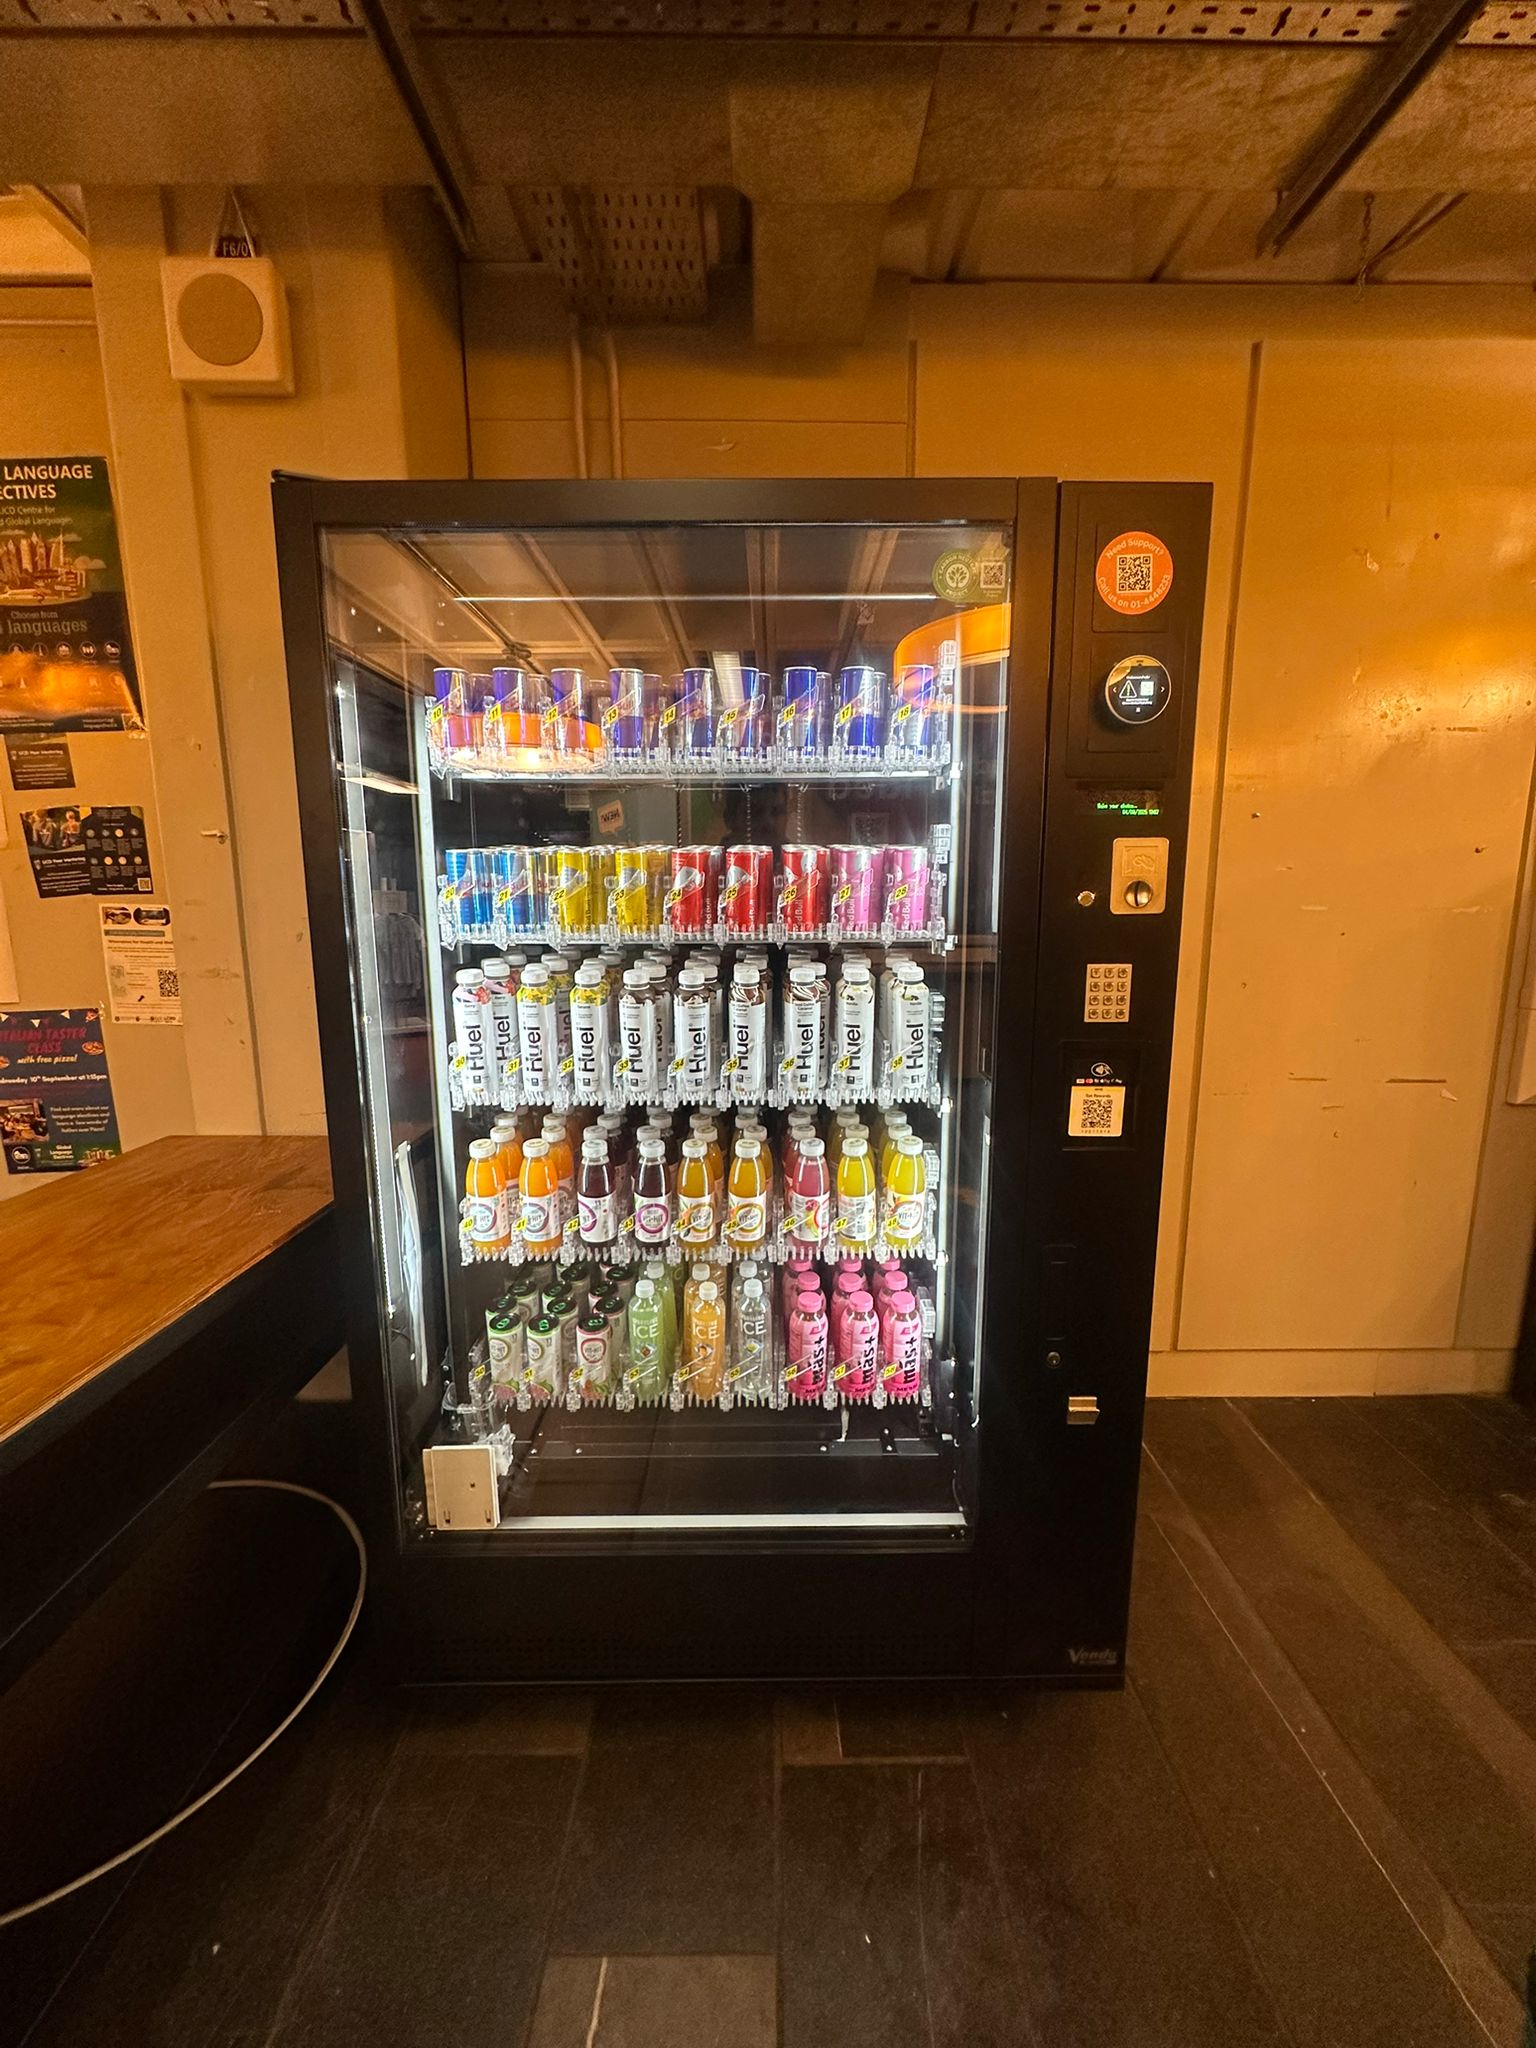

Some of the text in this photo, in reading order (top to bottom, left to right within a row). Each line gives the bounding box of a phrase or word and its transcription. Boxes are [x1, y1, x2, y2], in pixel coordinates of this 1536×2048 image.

[4, 465, 93, 480] LANGUAGE
[17, 505, 43, 515] Centre
[44, 504, 56, 513] for
[1105, 538, 1165, 559] Need Support?
[1099, 577, 1111, 594] Call
[1108, 594, 1118, 603] us
[1118, 600, 1129, 608] on
[8, 620, 88, 636] languages
[432, 707, 443, 719] 10
[490, 706, 500, 718] 11
[607, 708, 617, 720] 13
[664, 711, 674, 721] 14
[726, 710, 736, 721] 15
[785, 707, 795, 717] 16
[841, 708, 851, 718] 17
[899, 708, 909, 718] 18
[445, 887, 454, 898] 20
[500, 890, 508, 900] 21
[554, 890, 565, 900] 22
[615, 889, 625, 900] 23
[672, 889, 681, 900] 24
[728, 888, 737, 899] 25
[785, 889, 795, 899] 26
[840, 889, 850, 899] 27
[896, 888, 906, 898] 28
[847, 898, 855, 914] Bull
[902, 898, 910, 913] Bull
[47, 1027, 87, 1040] TASTER
[494, 1015, 511, 1061] Huel
[27, 1041, 61, 1054] CLASS
[467, 1024, 485, 1071] Huel
[526, 1026, 543, 1073] Huel
[579, 1027, 596, 1073] Huel
[624, 1027, 643, 1073] Huel
[689, 1027, 706, 1073] Huel
[734, 1024, 749, 1071] Huel
[797, 1023, 813, 1069] Huel
[846, 1024, 861, 1070] Huel
[906, 1023, 924, 1070] Huel
[17, 1054, 78, 1064] with free pizza!
[456, 1056, 465, 1068] 30
[508, 1059, 518, 1071] 31
[563, 1060, 572, 1070] 32
[727, 1059, 737, 1070] 35
[839, 1058, 849, 1068] 37
[42, 1074, 77, 1083] September
[632, 1321, 660, 1339] ICE
[692, 1321, 720, 1340] ICE
[740, 1319, 767, 1336] ICE
[836, 1366, 845, 1375] 57
